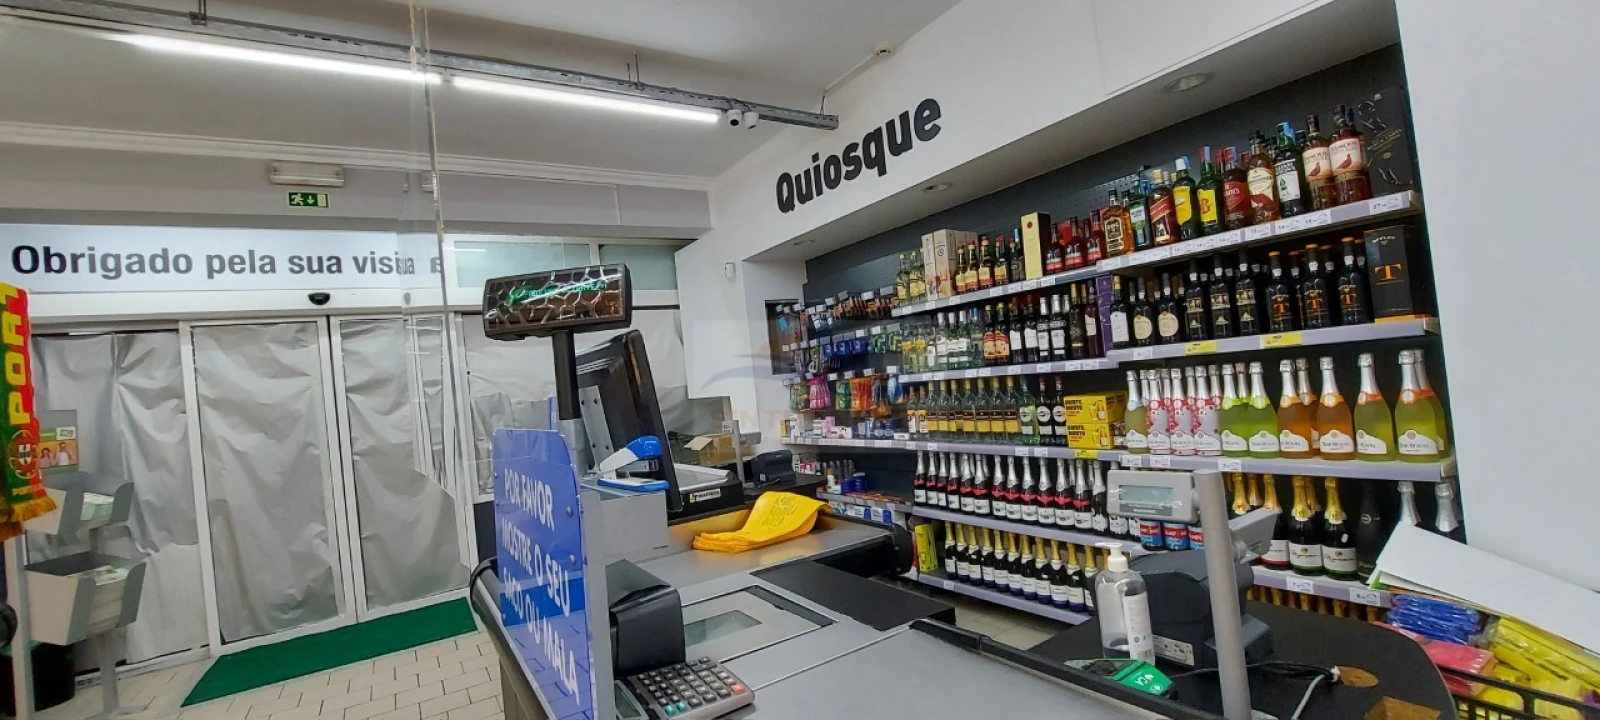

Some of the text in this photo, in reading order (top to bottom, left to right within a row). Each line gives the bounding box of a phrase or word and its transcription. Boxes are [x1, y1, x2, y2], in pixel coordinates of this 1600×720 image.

[776, 98, 942, 214] Quiosque
[11, 244, 194, 280] Obrigado
[205, 248, 278, 280] pela
[288, 253, 343, 275] sua
[504, 467, 555, 532] POR FAVOR
[501, 516, 571, 617] MOSTRE O SEU
[525, 593, 541, 645] OU
[543, 614, 580, 706] MALA
